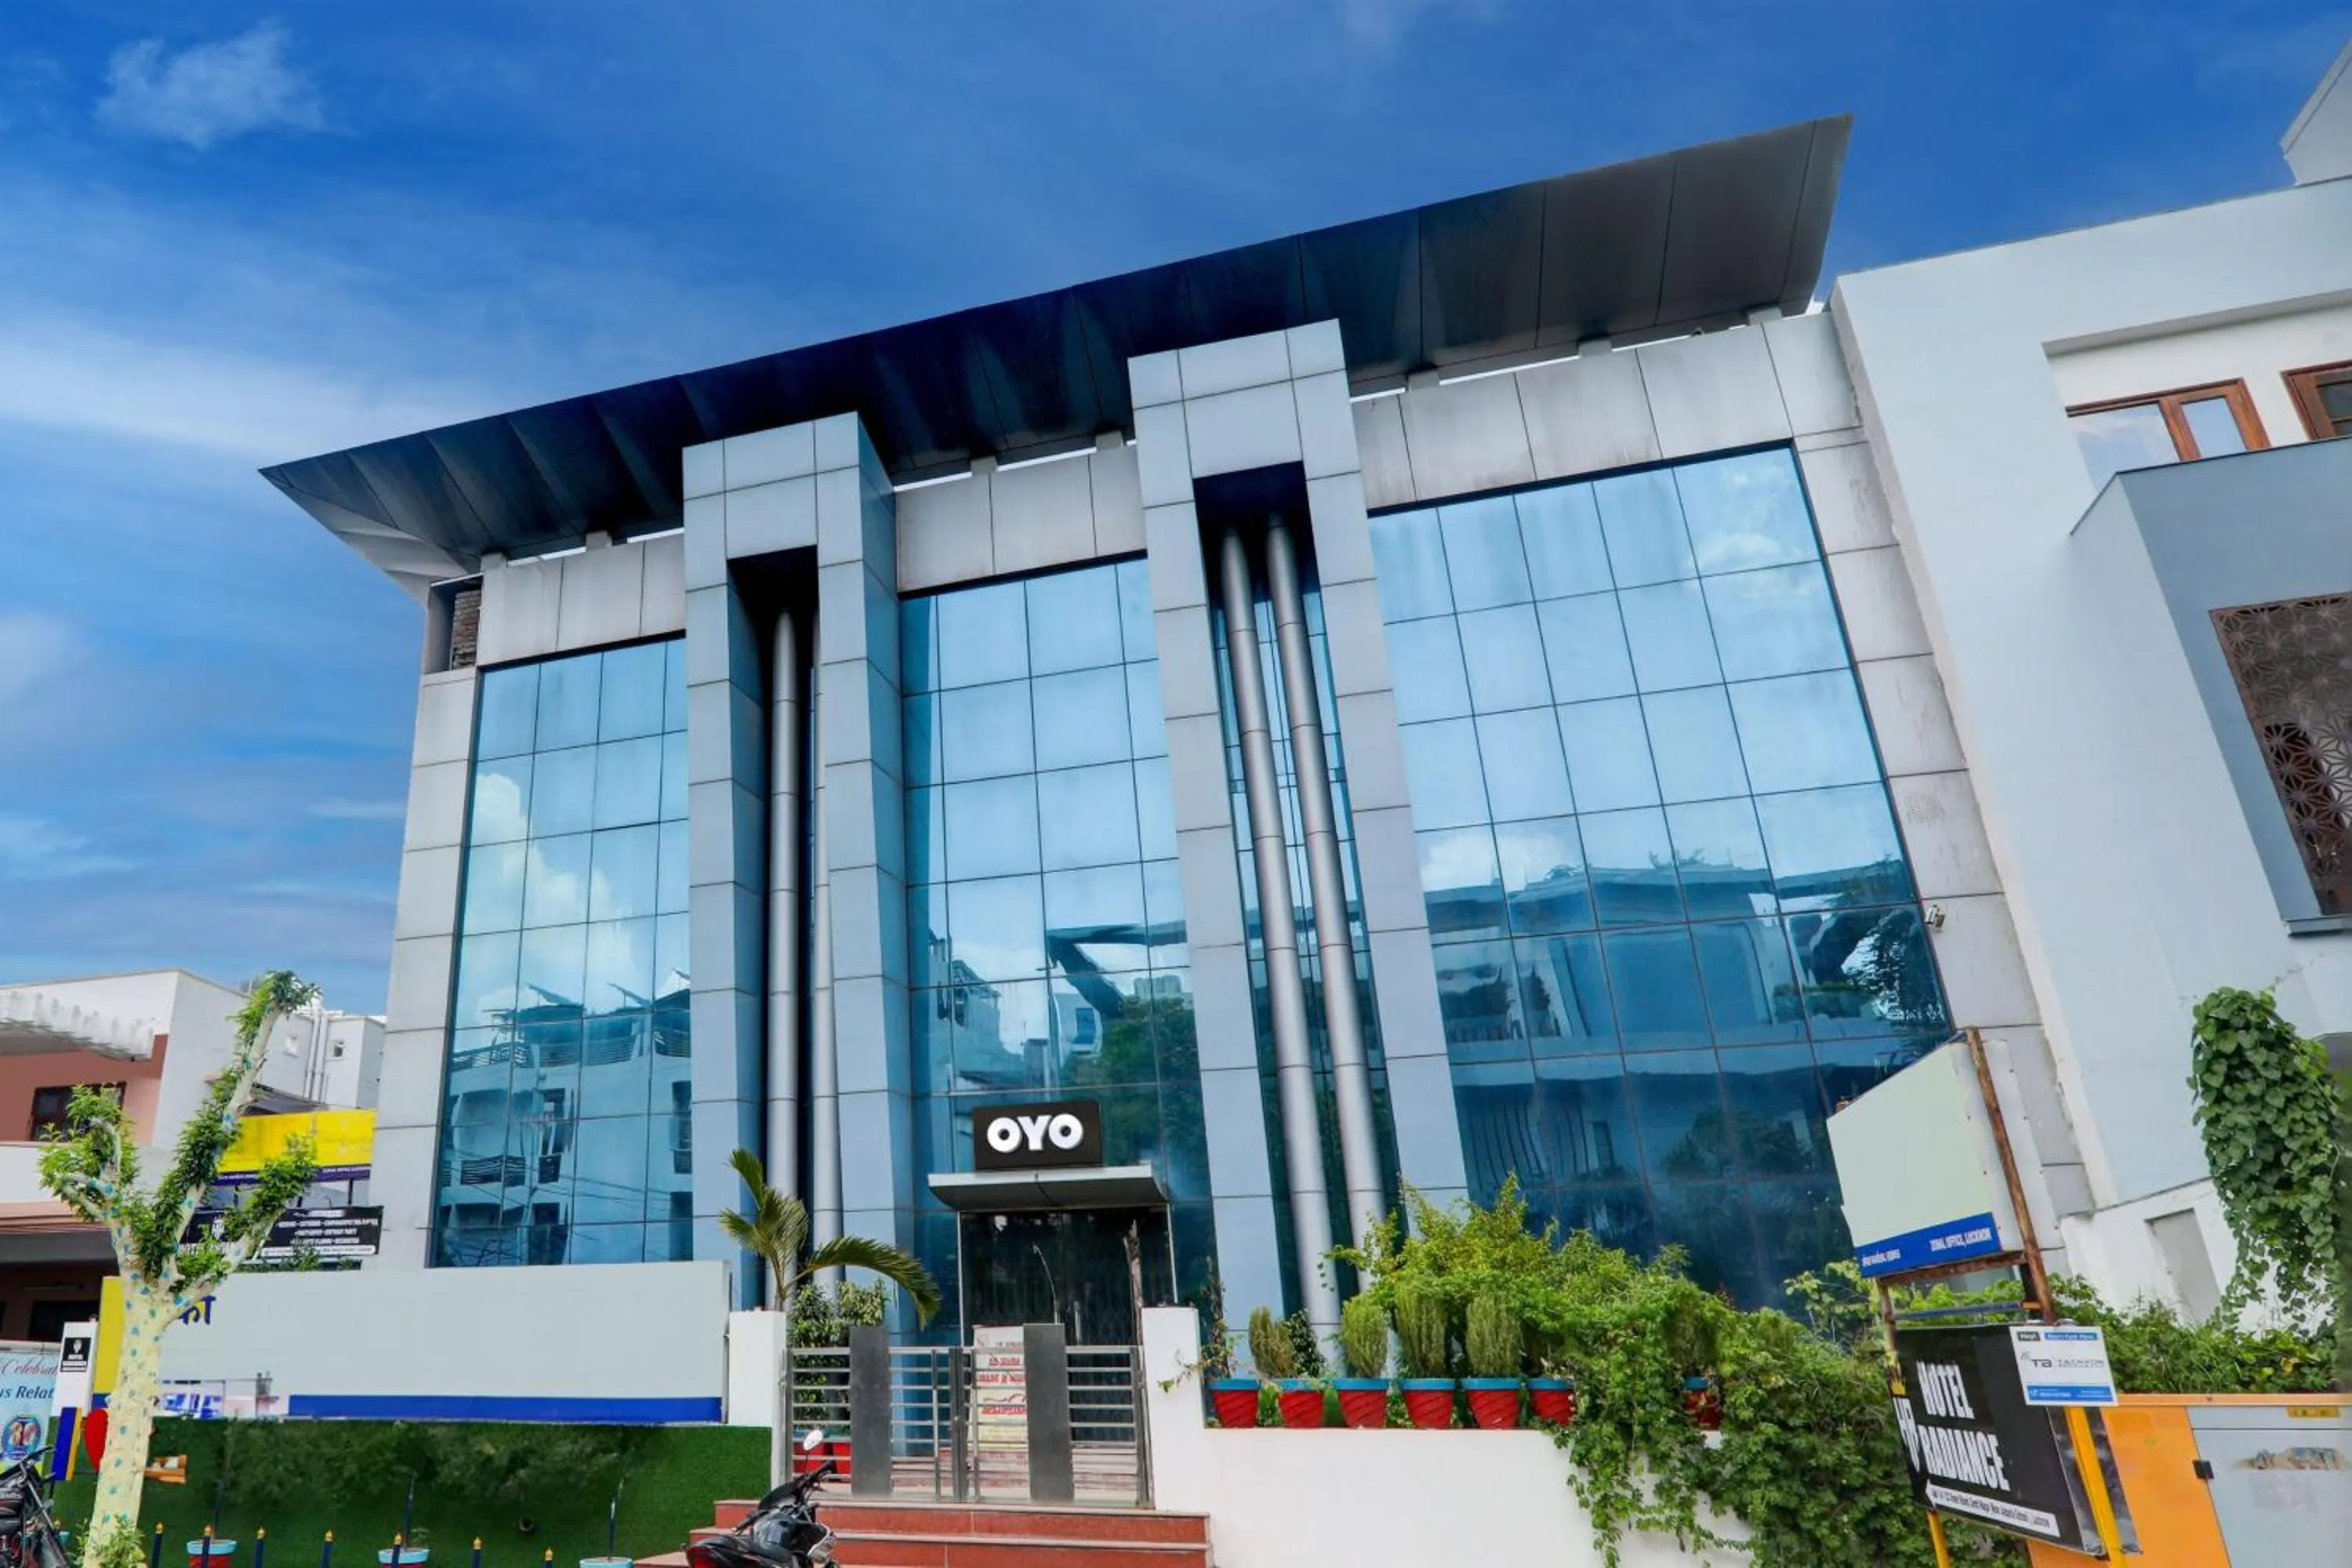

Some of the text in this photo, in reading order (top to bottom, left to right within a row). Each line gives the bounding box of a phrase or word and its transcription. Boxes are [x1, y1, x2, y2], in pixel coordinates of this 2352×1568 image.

[987, 1112, 1083, 1153] OYO
[1916, 1360, 1976, 1420] HOTEL
[1918, 1424, 2011, 1492] RADIANCE
